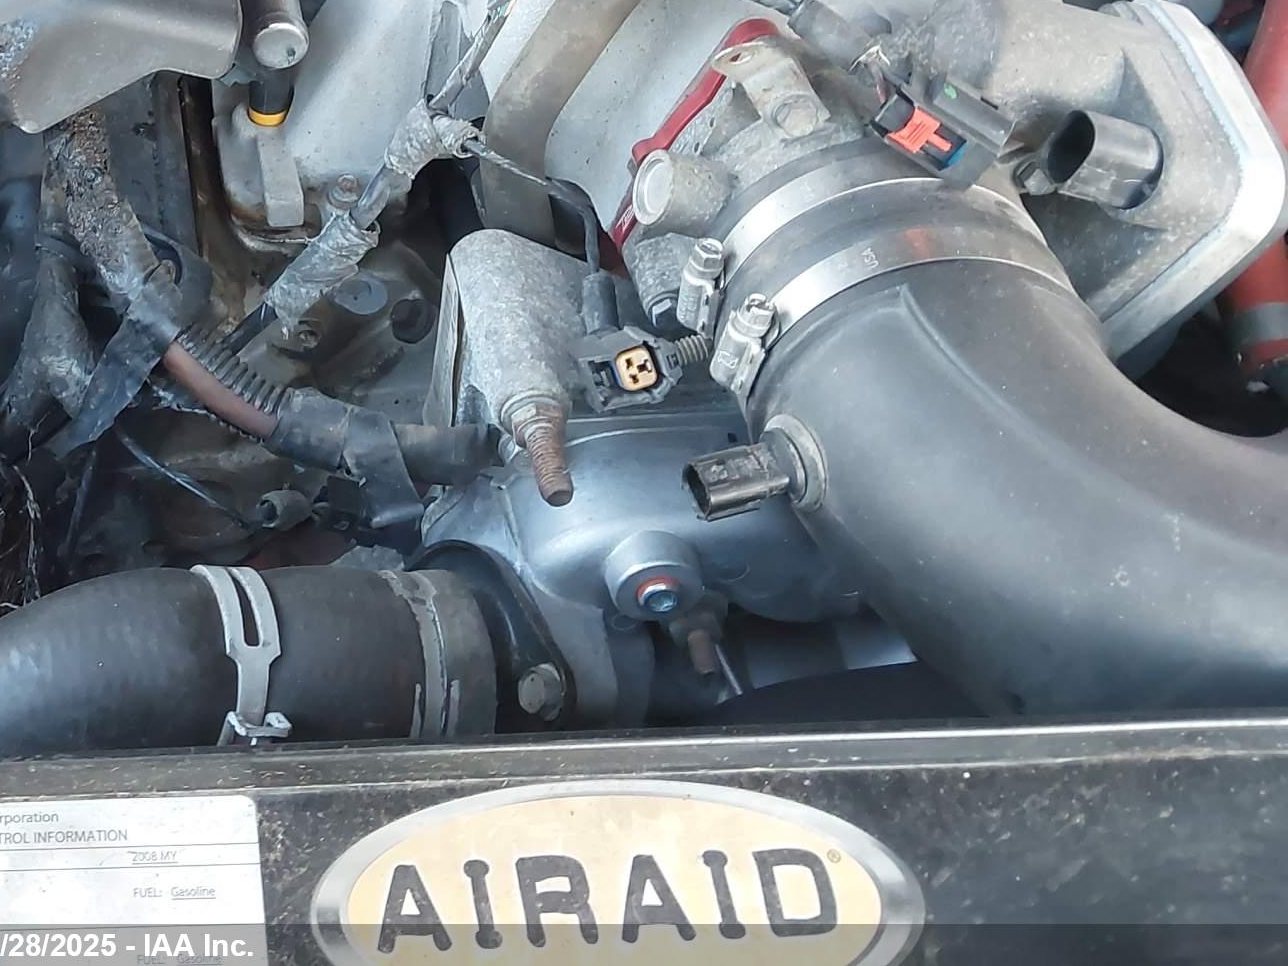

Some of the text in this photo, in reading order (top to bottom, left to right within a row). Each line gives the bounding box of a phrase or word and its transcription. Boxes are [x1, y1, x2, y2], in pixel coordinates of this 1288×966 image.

[861, 247, 879, 268] USA
[33, 829, 128, 843] INFORMATION
[171, 886, 216, 897] Gasoline
